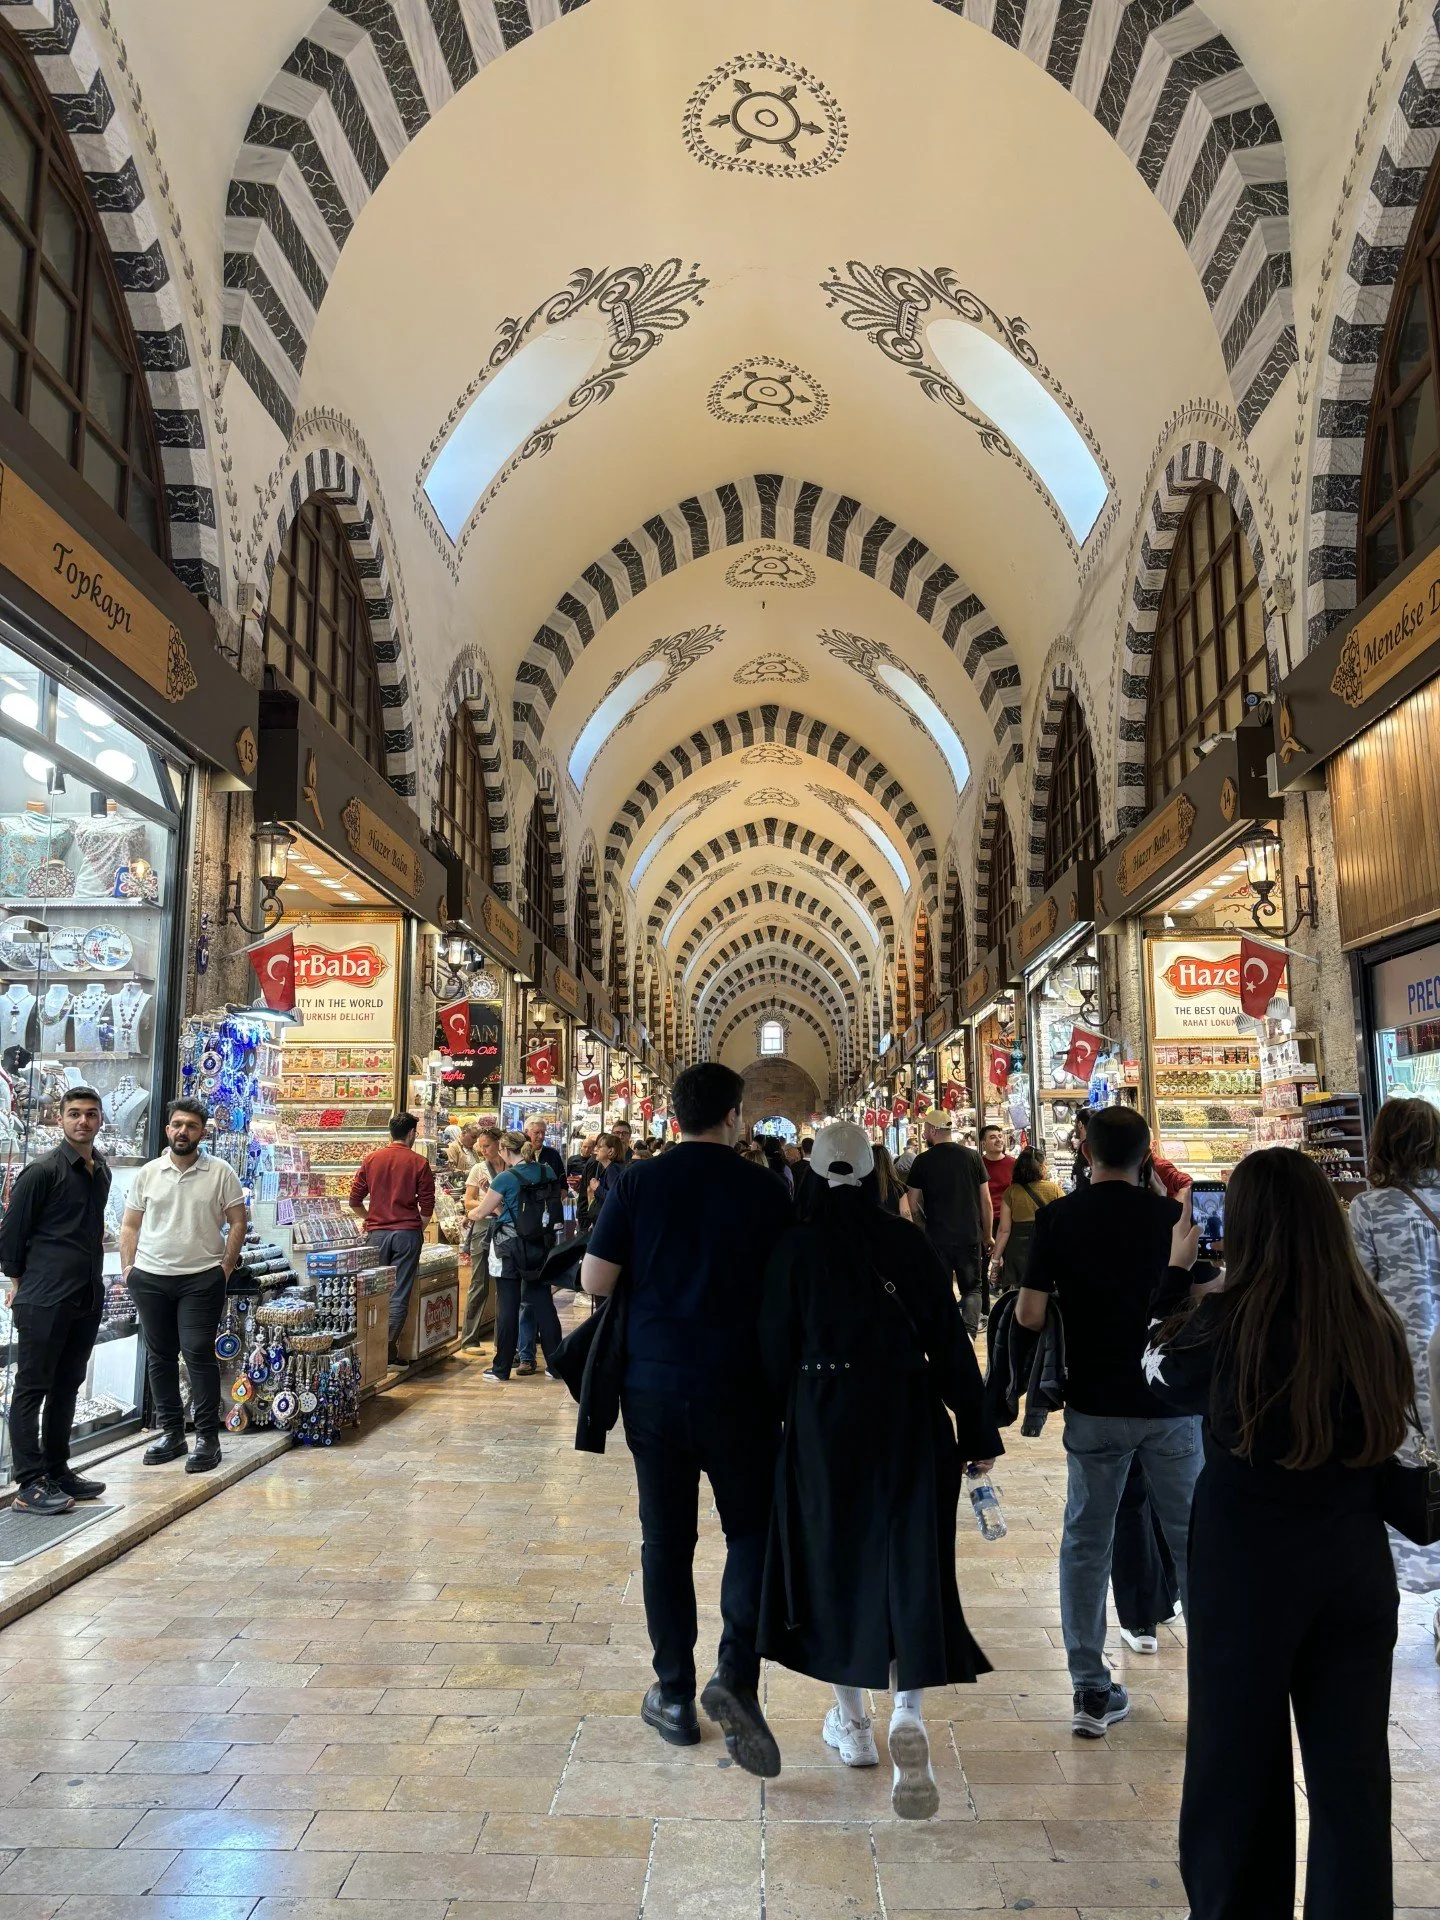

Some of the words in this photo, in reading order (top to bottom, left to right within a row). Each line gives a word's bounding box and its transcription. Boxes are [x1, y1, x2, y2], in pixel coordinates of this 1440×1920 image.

[52, 542, 132, 633] Topkapı
[243, 739, 254, 763] 13
[368, 829, 391, 861] Hazer
[1132, 848, 1152, 873] Hazer
[1179, 964, 1240, 986] Haze
[315, 999, 325, 1008] IN
[329, 999, 347, 1008] THE
[349, 999, 384, 1008] WORLD
[1175, 1006, 1192, 1015] THE
[1194, 1006, 1216, 1015] BEST
[1219, 1006, 1242, 1016] QUAL
[340, 1012, 376, 1021] DELIGHT
[1182, 1019, 1208, 1027] RAHAT
